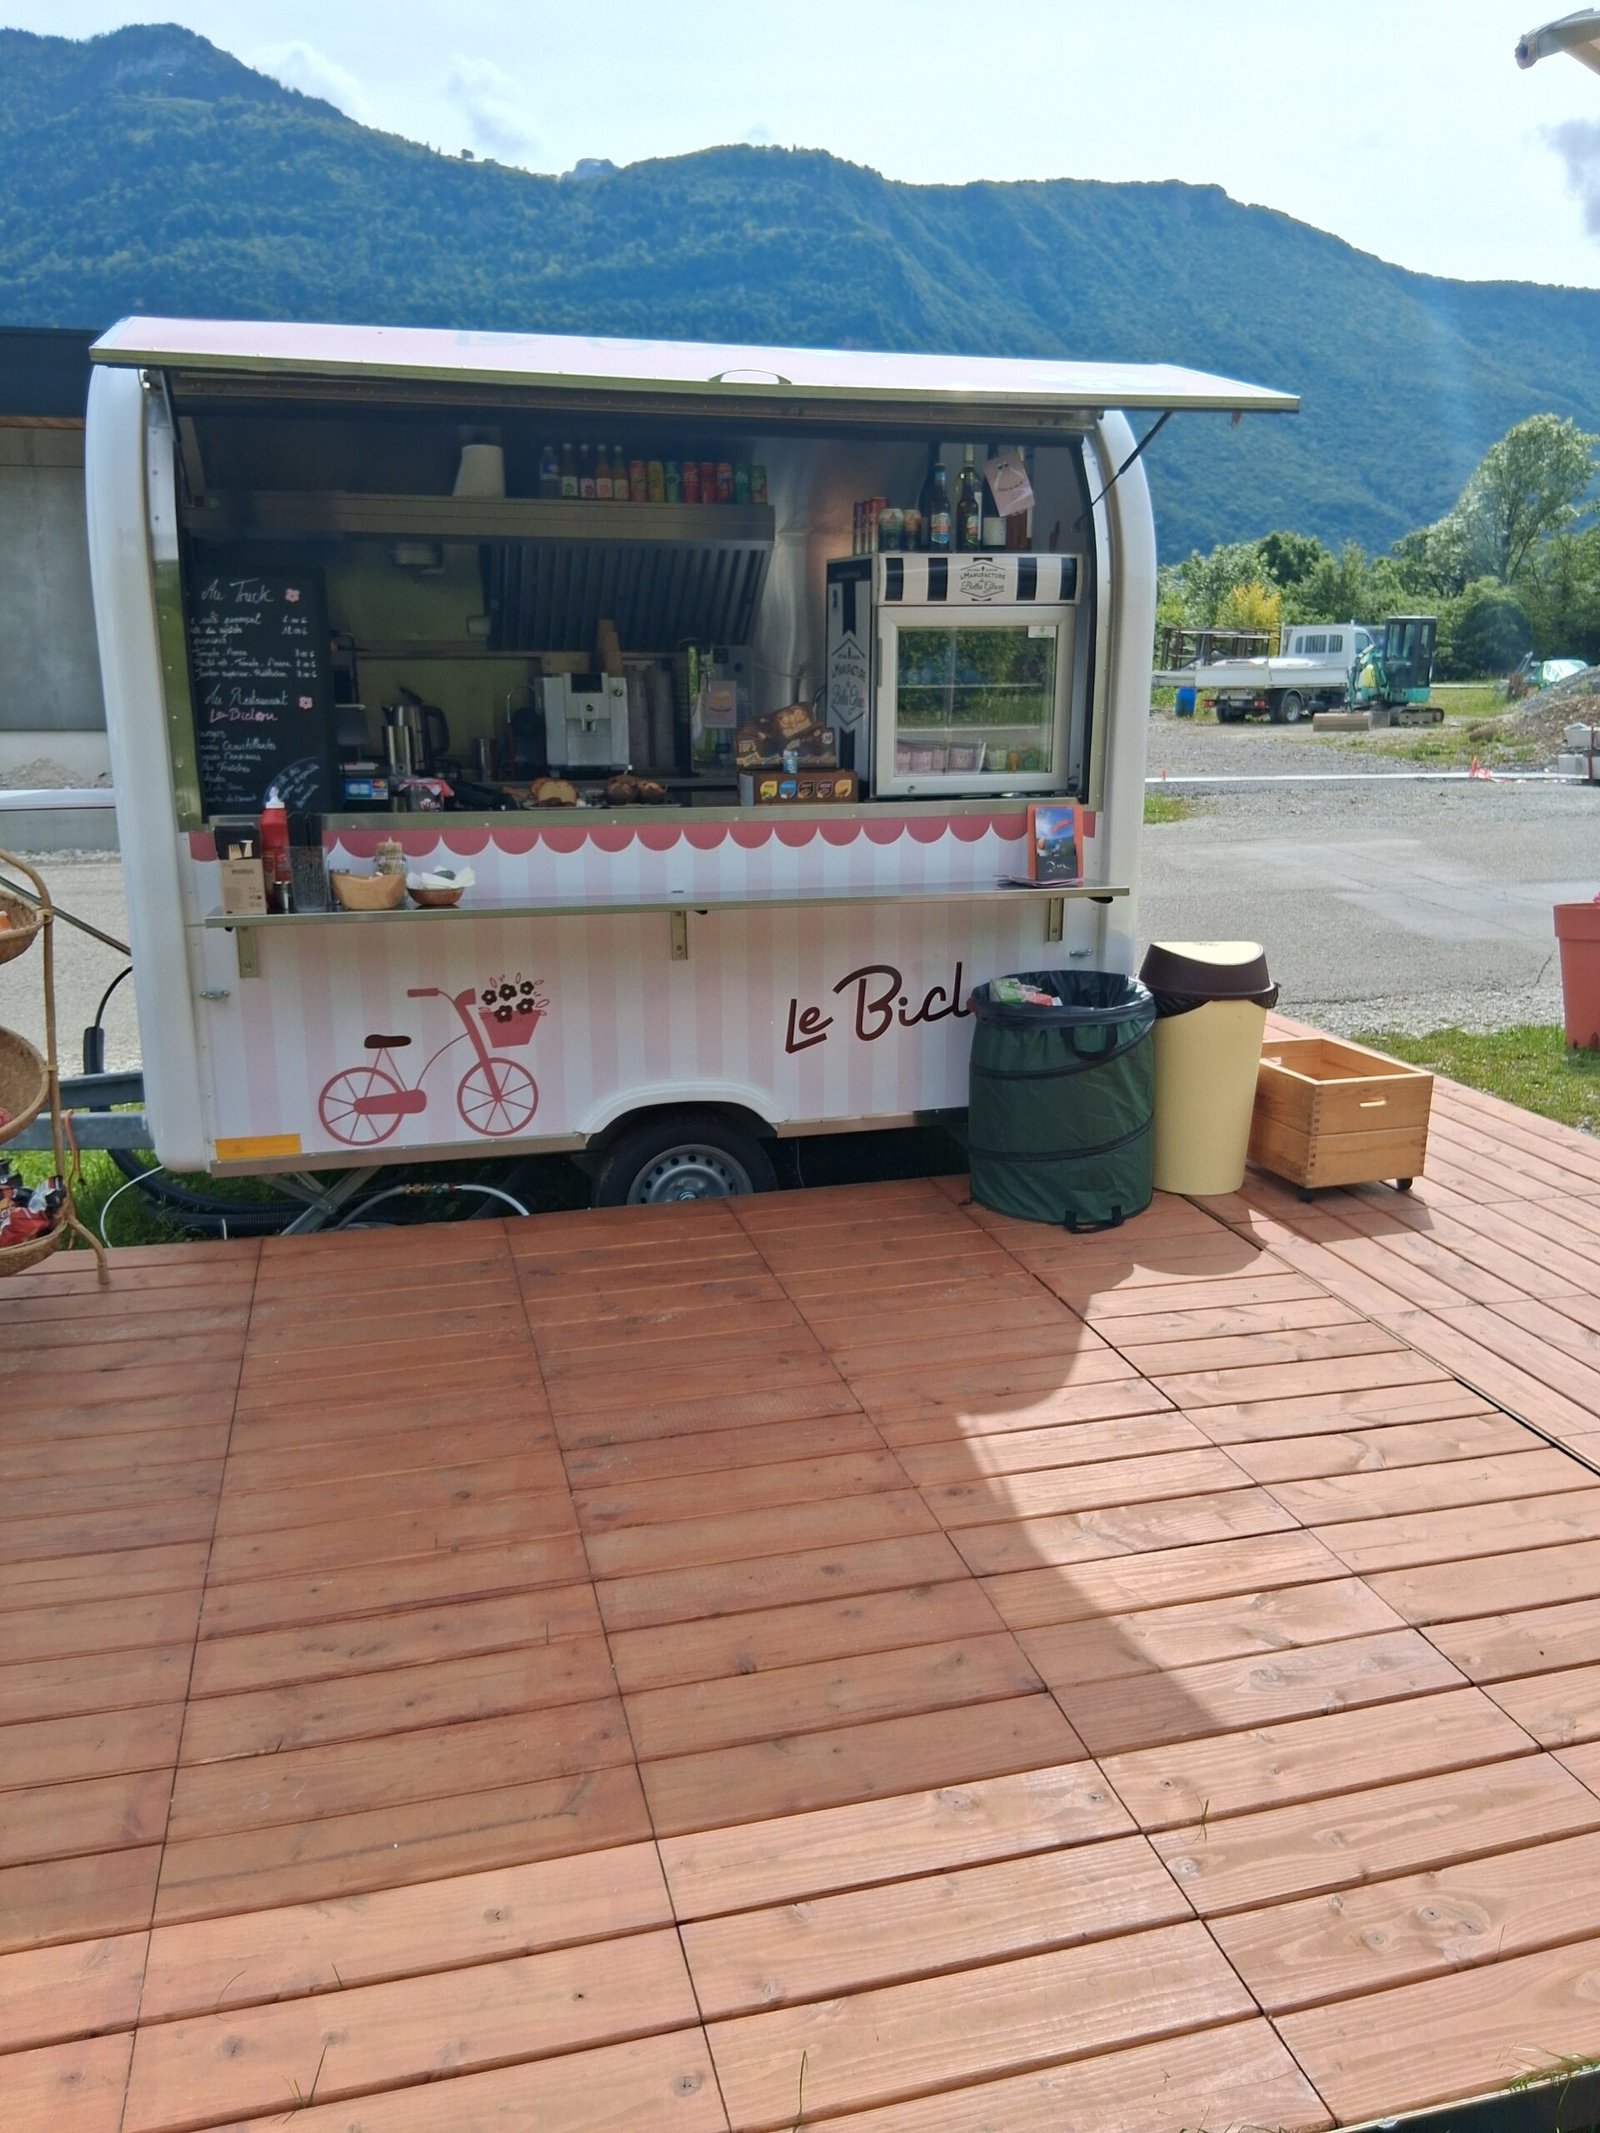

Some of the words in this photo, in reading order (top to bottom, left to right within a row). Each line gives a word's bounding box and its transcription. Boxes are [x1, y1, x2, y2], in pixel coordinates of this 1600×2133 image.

[229, 578, 275, 604] Truck
[785, 998, 835, 1055] Le
[832, 961, 972, 1042] Bicl
